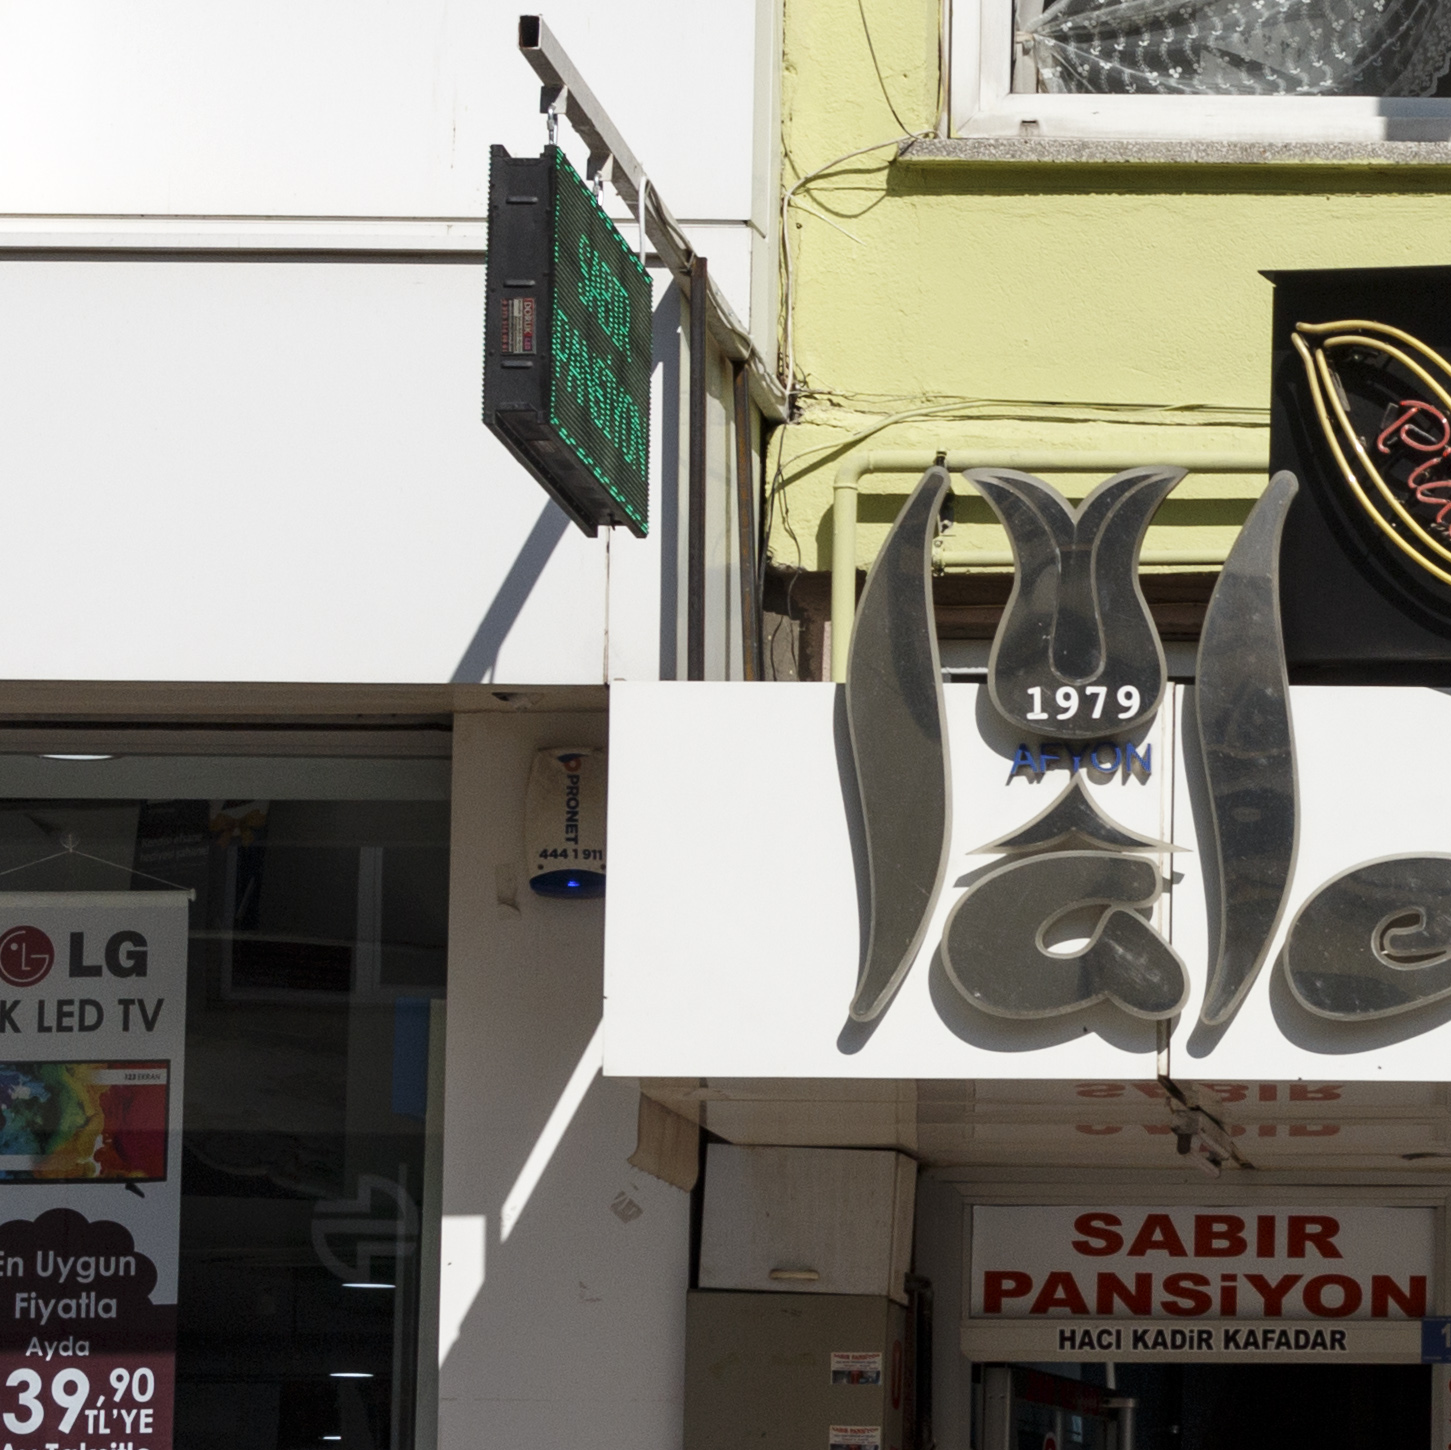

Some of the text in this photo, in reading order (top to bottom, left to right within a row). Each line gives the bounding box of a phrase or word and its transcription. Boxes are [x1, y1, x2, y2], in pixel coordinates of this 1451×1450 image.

[1026, 685, 1141, 720] 1979
[1010, 742, 1152, 774] AFYON
[565, 774, 580, 845] PRONET
[540, 848, 568, 860] 444
[68, 930, 149, 978] LG
[37, 999, 104, 1033] LED
[118, 999, 165, 1033] TV
[1071, 1212, 1343, 1259] SABIR
[36, 1251, 136, 1283] Uygun
[14, 1292, 117, 1325] Fiyatla
[25, 1336, 90, 1361] Ayda
[1058, 1328, 1122, 1350] HACI
[1223, 1329, 1347, 1351] KAFADAR
